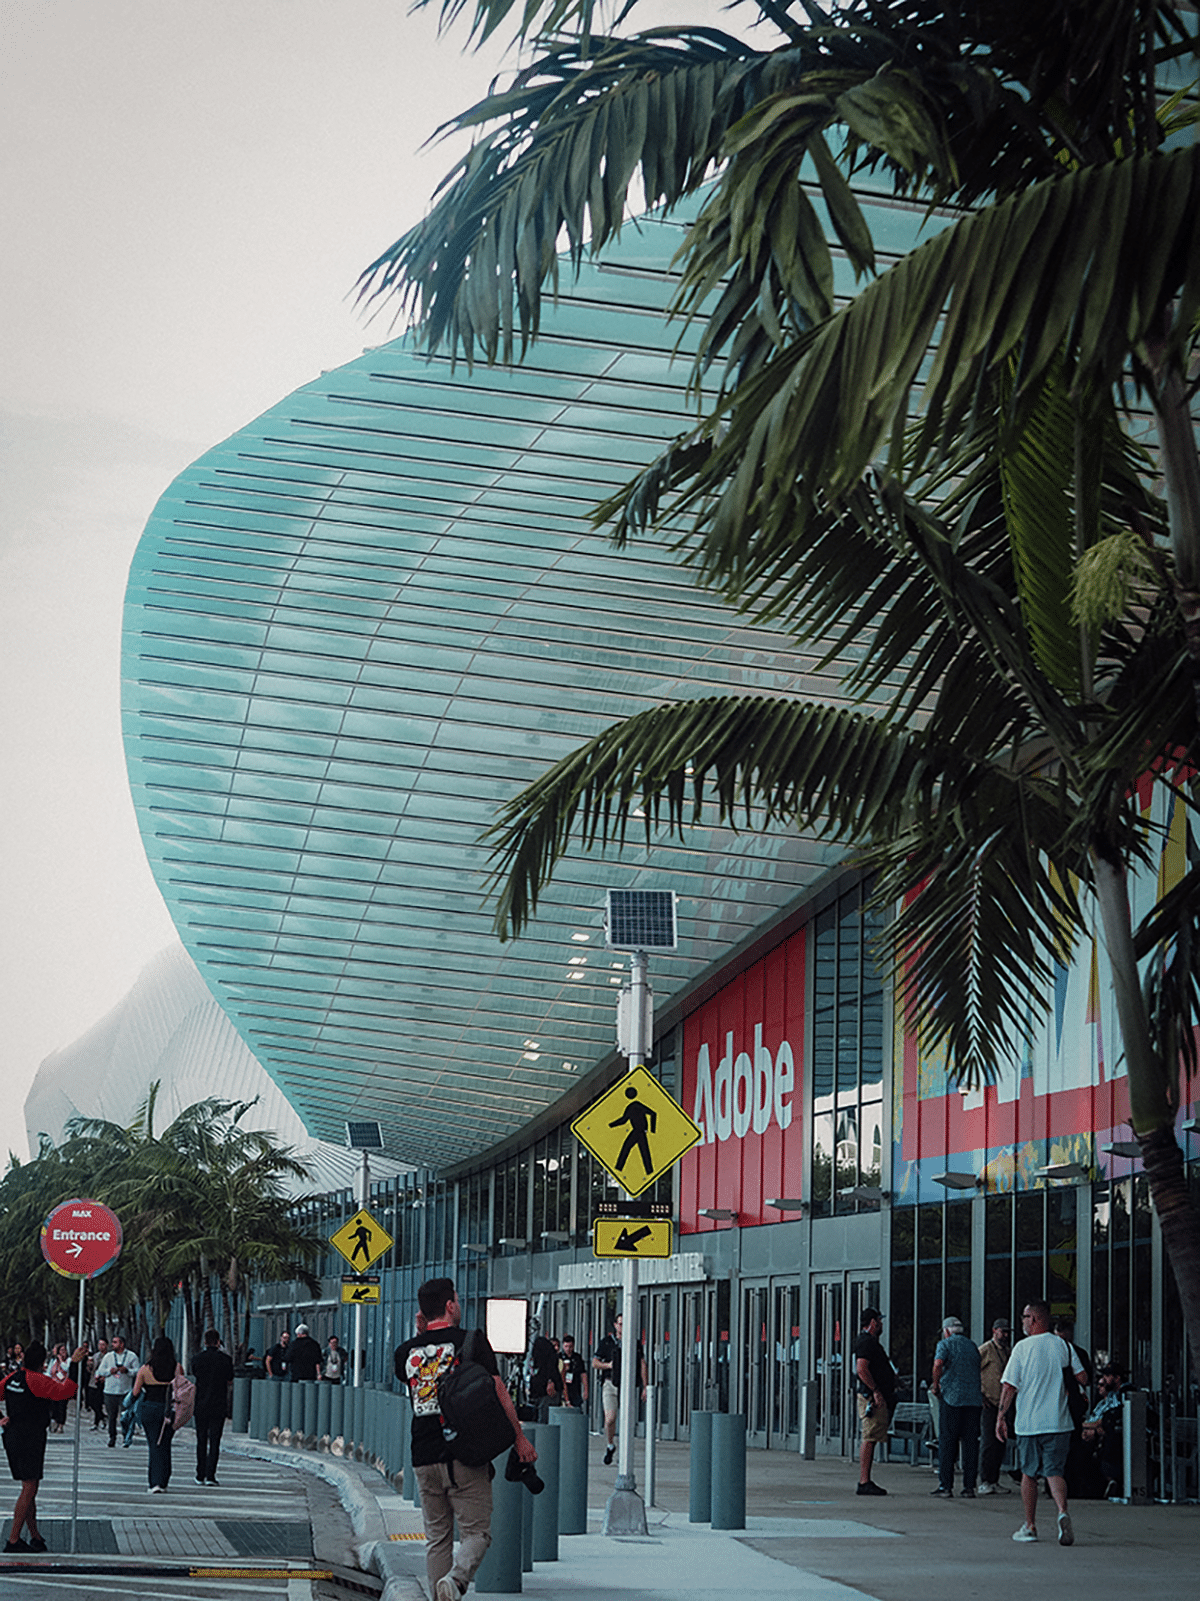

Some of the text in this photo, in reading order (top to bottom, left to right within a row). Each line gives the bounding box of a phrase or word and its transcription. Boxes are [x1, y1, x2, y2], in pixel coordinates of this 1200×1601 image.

[693, 1022, 795, 1147] Adobe
[72, 1209, 93, 1218] MAX
[52, 1228, 111, 1241] Entrance
